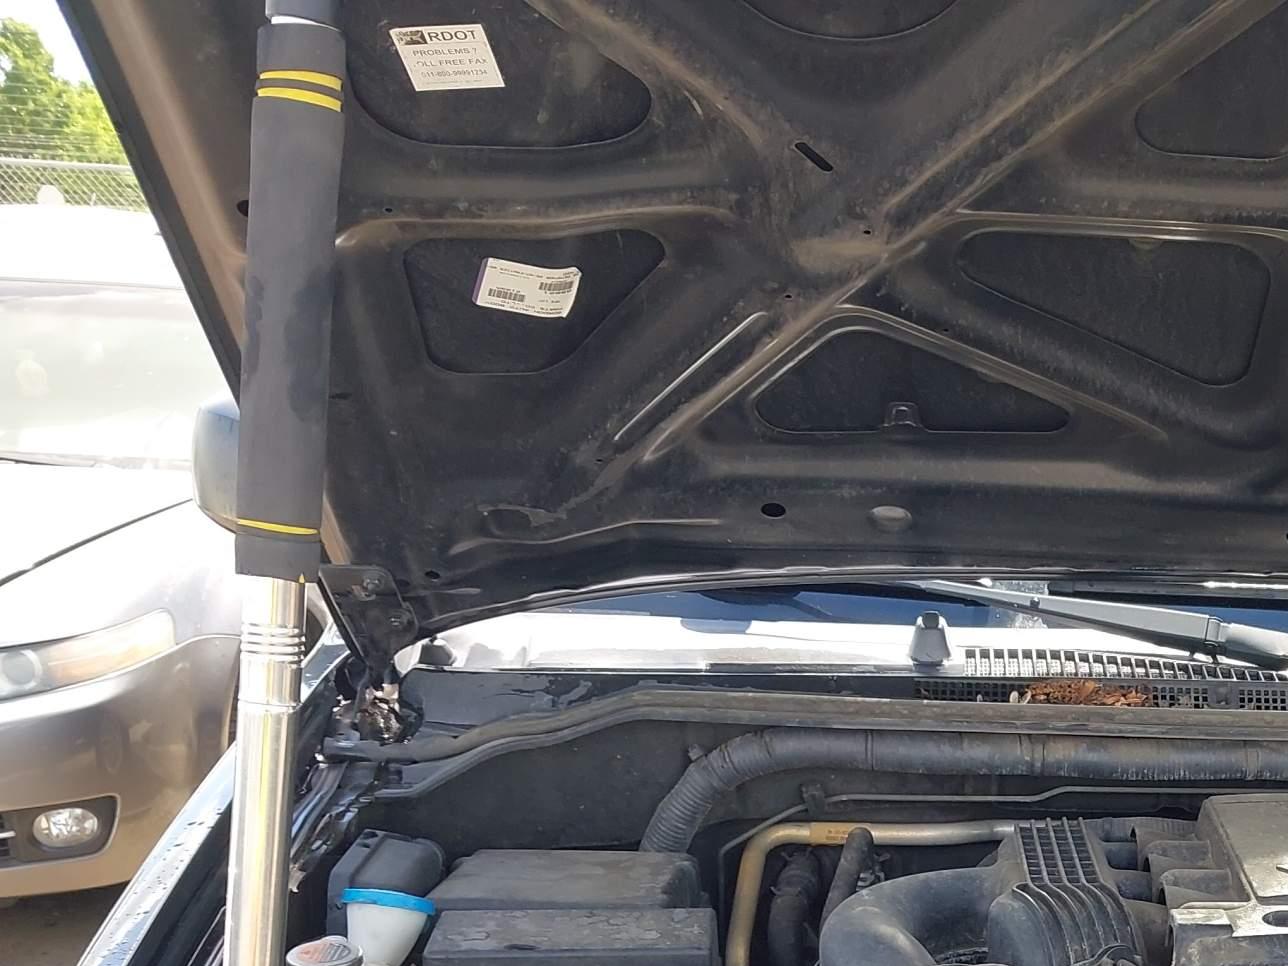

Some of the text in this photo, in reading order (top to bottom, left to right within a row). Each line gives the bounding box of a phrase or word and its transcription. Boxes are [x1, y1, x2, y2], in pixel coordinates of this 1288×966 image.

[427, 30, 477, 42] RDOT
[412, 47, 471, 57] PROBLEMS
[439, 58, 465, 66] FREE
[468, 57, 488, 65] FAX
